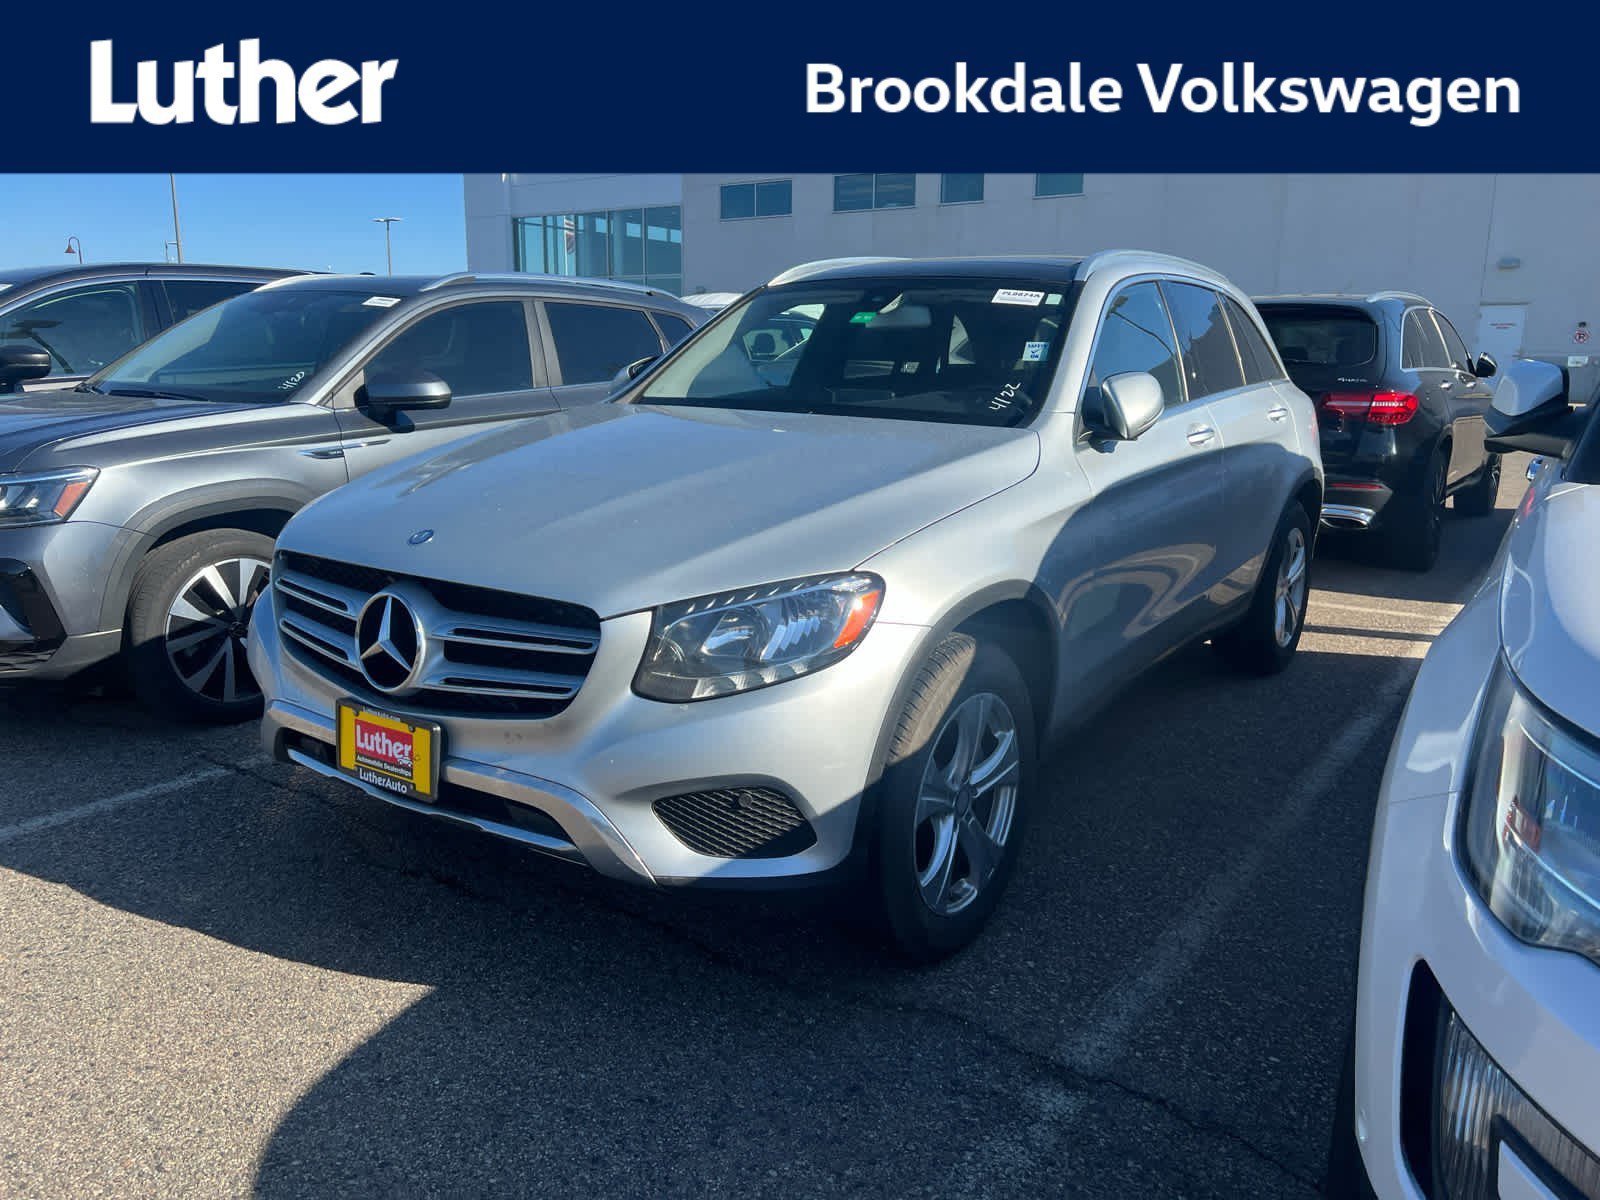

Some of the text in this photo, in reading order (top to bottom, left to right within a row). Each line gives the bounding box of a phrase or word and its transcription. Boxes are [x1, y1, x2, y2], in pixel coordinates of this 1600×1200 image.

[988, 382, 1022, 410] 4122
[356, 724, 412, 759] Luther
[359, 768, 408, 793] LutherAuto
